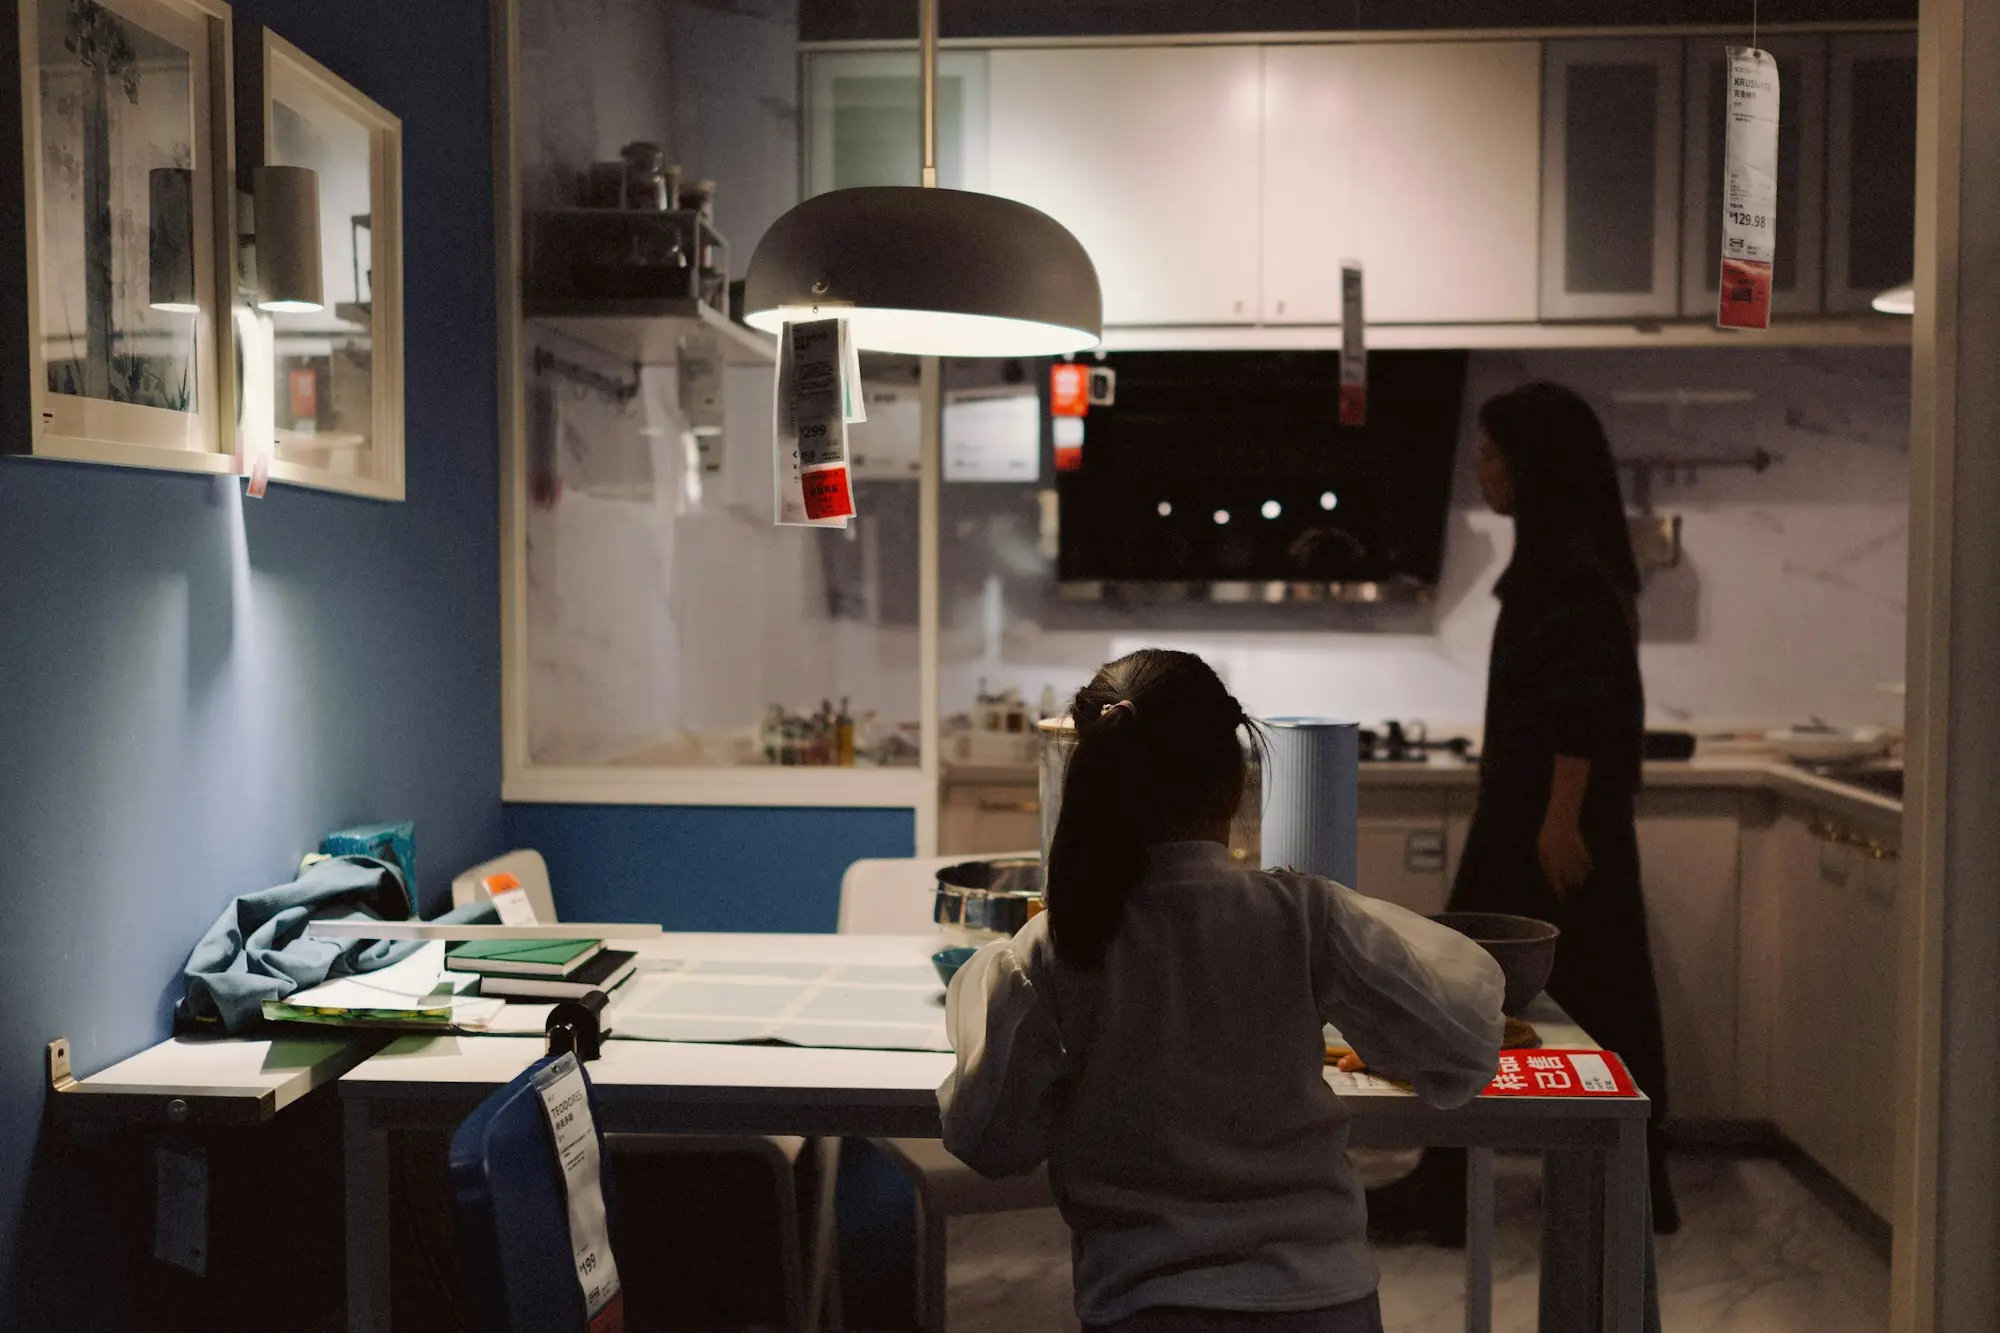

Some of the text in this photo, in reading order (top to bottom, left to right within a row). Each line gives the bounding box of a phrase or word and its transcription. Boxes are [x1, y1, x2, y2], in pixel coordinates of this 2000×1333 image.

[1729, 212, 1766, 228] ¥129.98
[1492, 1056, 1528, 1089] 样品
[1526, 1056, 1571, 1089] 已售
[551, 1090, 582, 1118] TEODORES
